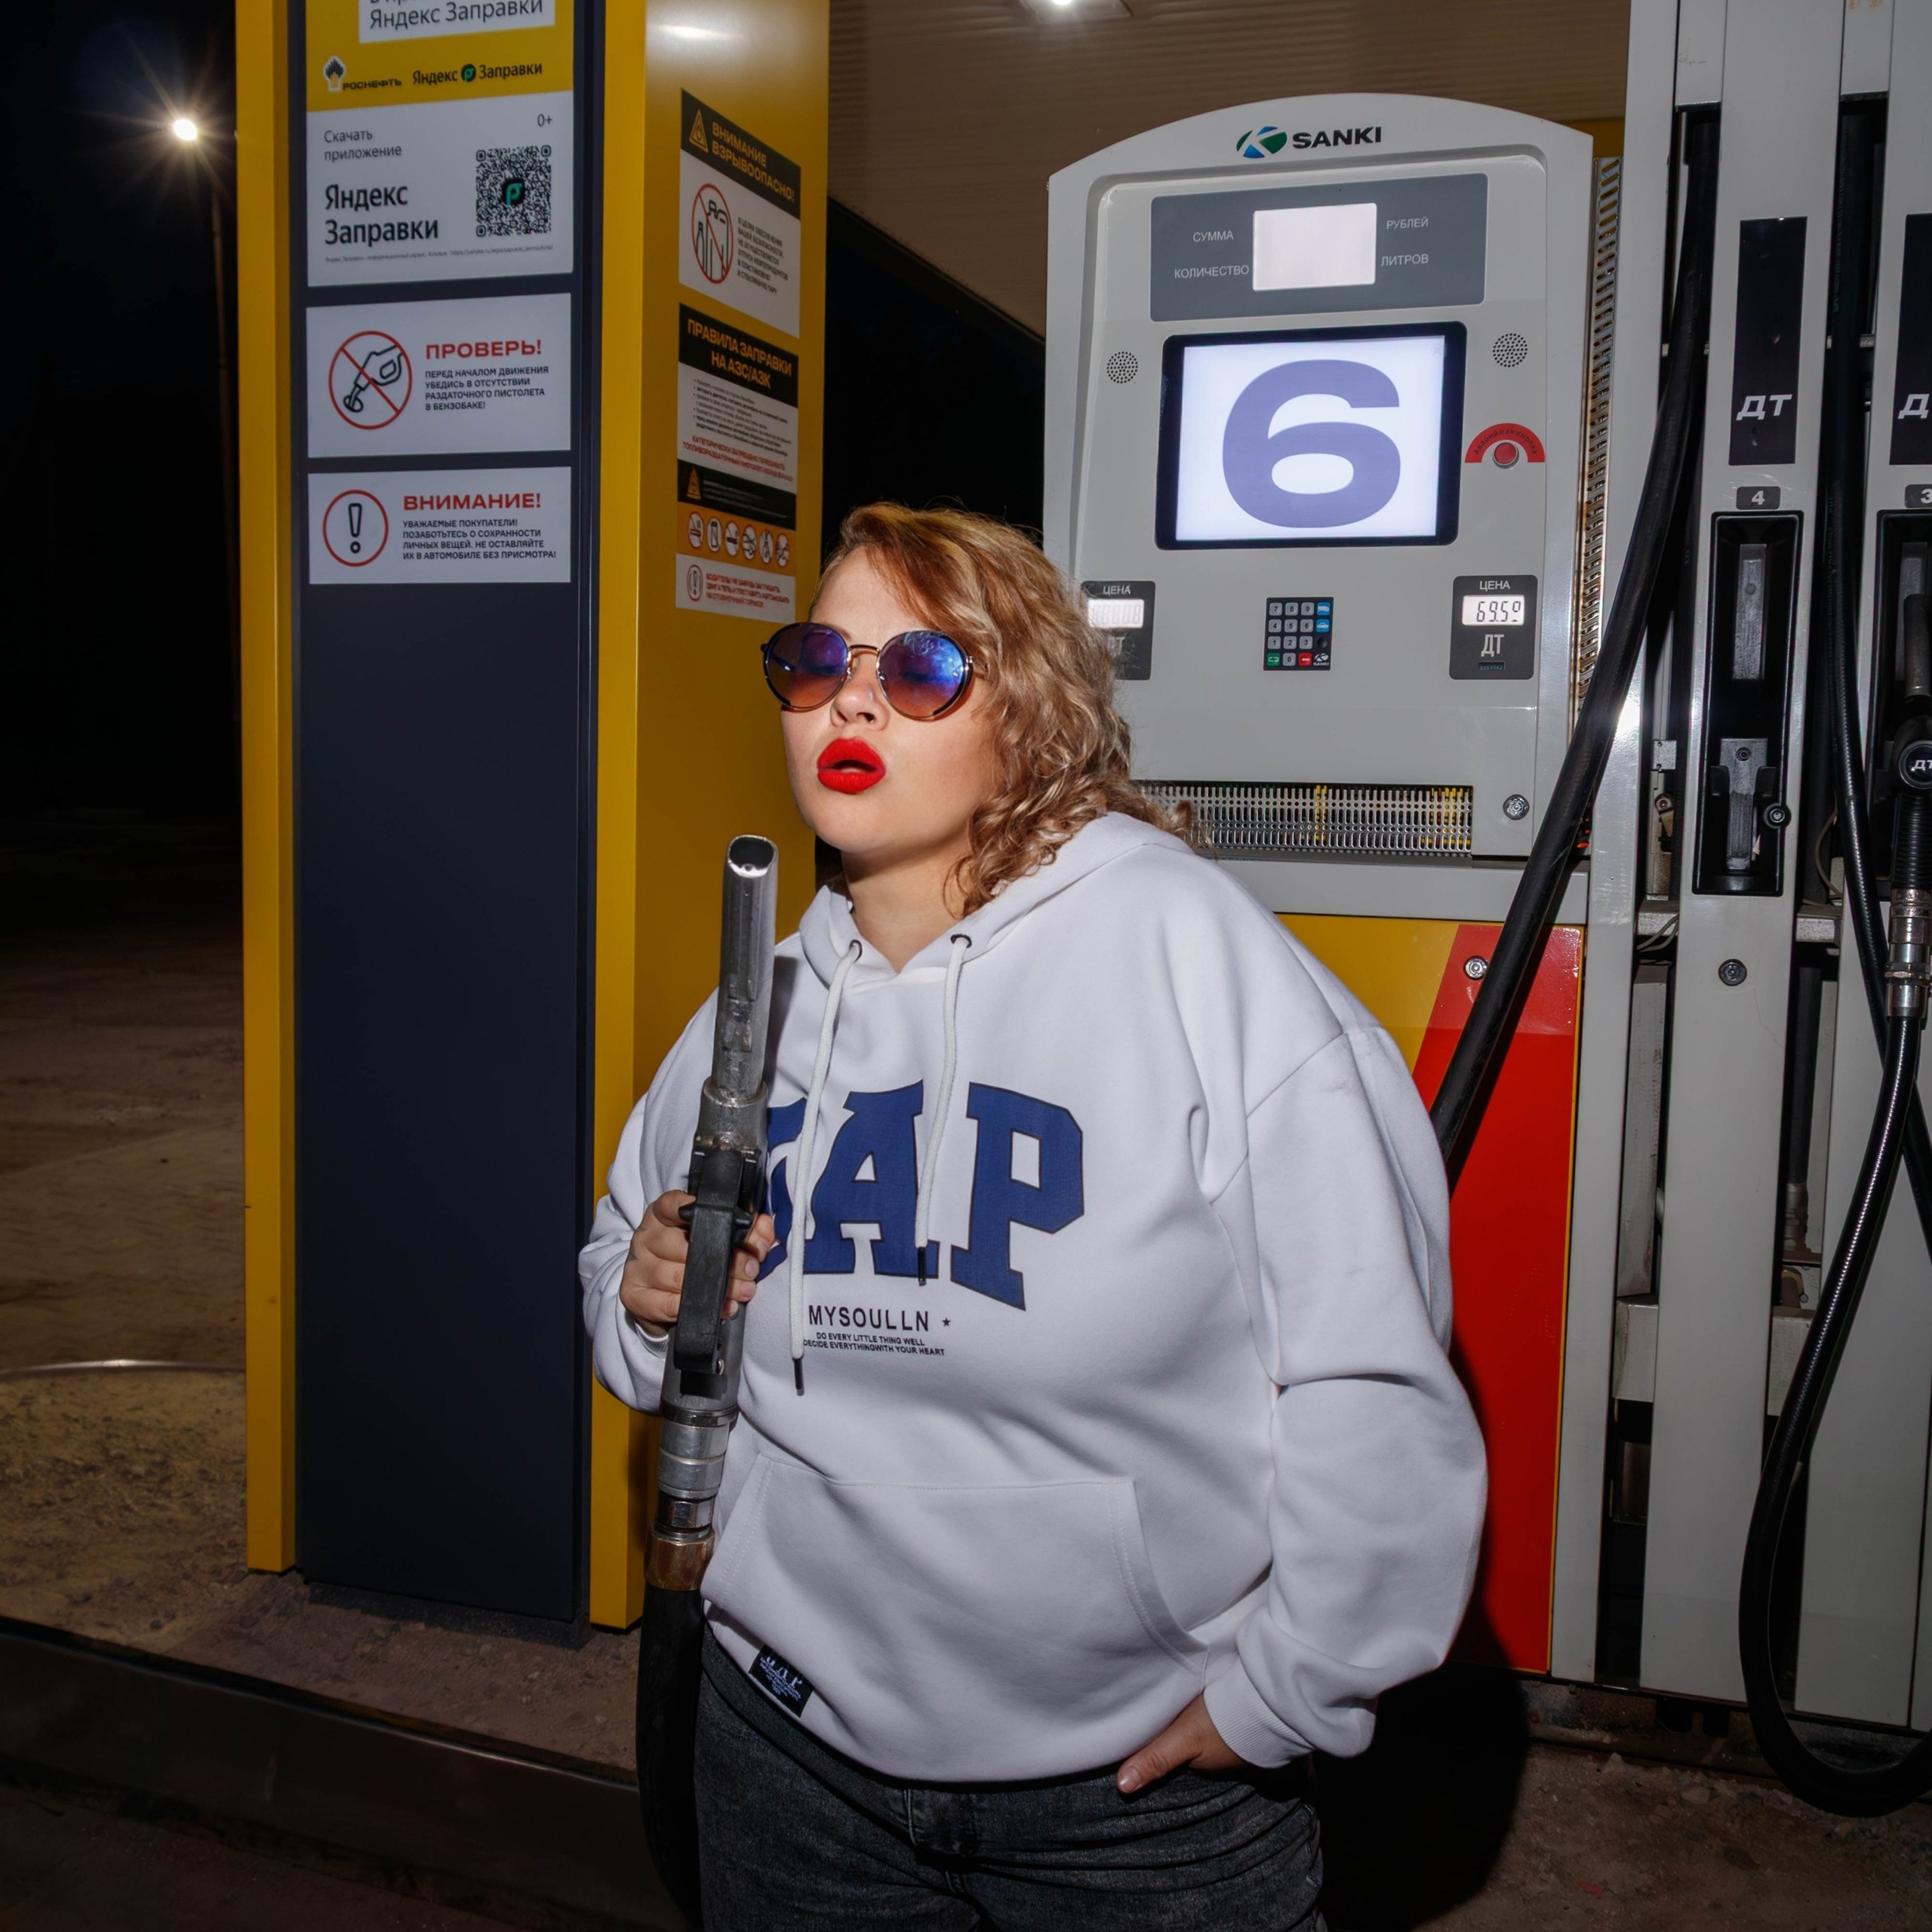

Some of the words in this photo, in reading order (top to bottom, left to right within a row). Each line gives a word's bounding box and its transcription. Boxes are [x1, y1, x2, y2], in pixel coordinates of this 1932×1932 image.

[370, 8, 440, 29] Яндекс
[445, 0, 543, 22] Заправки
[412, 69, 458, 85] Яндекс
[478, 63, 543, 82] Заправки
[342, 78, 402, 90] РОСНЕФТЬ
[537, 113, 552, 127] 0+
[324, 130, 373, 143] Скачать
[1292, 126, 1382, 149] SANKI
[712, 122, 767, 168] ВНИМАНИЕ
[325, 144, 402, 162] приложение
[712, 140, 795, 202] ВЗРЫВООПАСНО!
[325, 183, 408, 211] Яндекс
[1386, 216, 1429, 230] РУБЛЕЙ
[325, 219, 438, 247] Заправки
[1192, 230, 1234, 242] СУММА
[1381, 254, 1429, 267] ЛИТРОВ
[1174, 264, 1249, 278] КОЛИЧЕСТВО
[426, 340, 542, 359] ПРОВЕРЬ!
[688, 318, 738, 355] ПРАВИЛА
[740, 343, 792, 376] ЗАПРАВКИ
[425, 370, 453, 379] ПЕРЕД
[455, 368, 497, 377] НАЧАЛОМ
[498, 366, 549, 377] ДВИЖЕНИЯ
[712, 351, 727, 370] НА
[728, 356, 771, 389] АЗС/АЗК
[425, 380, 464, 389] УБЕДИСЬ
[474, 378, 531, 387] ОТСУТСТВИИ
[425, 390, 492, 400] РАЗДАТОЧНОГО
[494, 388, 545, 398] ПИСТОЛЕТА
[426, 402, 431, 411] В
[433, 401, 486, 411] БЕНЗОБАКЕ!
[1737, 394, 1792, 420] ДТ
[1897, 393, 1930, 420] Д
[1223, 359, 1401, 528] 6
[403, 493, 542, 510] ВНИМАНИЕ!
[1751, 491, 1765, 505] 4
[1921, 488, 1932, 503] 3
[403, 520, 457, 528] УВАЖАЕМЫЕ
[459, 518, 518, 528] ПОКУПАТЕЛИ!
[403, 530, 468, 539] ПОЗАБОТЬТЕСЬ
[478, 529, 541, 538] СОХРАННОСТИ
[403, 540, 438, 549] ЛИЧНЫХ
[441, 539, 473, 550] ВЕЩЕЙ.
[475, 540, 486, 549] НЕ
[488, 538, 544, 548] ОСТАВЛЯЙТЕ
[403, 552, 414, 560] ИХ
[423, 551, 481, 560] АВТОМОБИЛЕ
[483, 551, 499, 559] БЕЗ
[501, 550, 556, 559] ПРИСМОТРА!
[1103, 586, 1131, 595] ЦЕНА
[1479, 580, 1511, 592] ЦЕНА
[1481, 634, 1505, 657] ДТ
[1910, 759, 1932, 772] ДТ
[808, 1305, 929, 1331] MYSOULLN
[828, 1333, 851, 1342] EVERY
[854, 1334, 878, 1343] LITTLE
[879, 1336, 901, 1345] THING
[903, 1337, 925, 1346] WELL
[804, 1340, 828, 1349] DECIDE
[895, 1346, 918, 1355] YOUR
[918, 1347, 945, 1356] HEART
